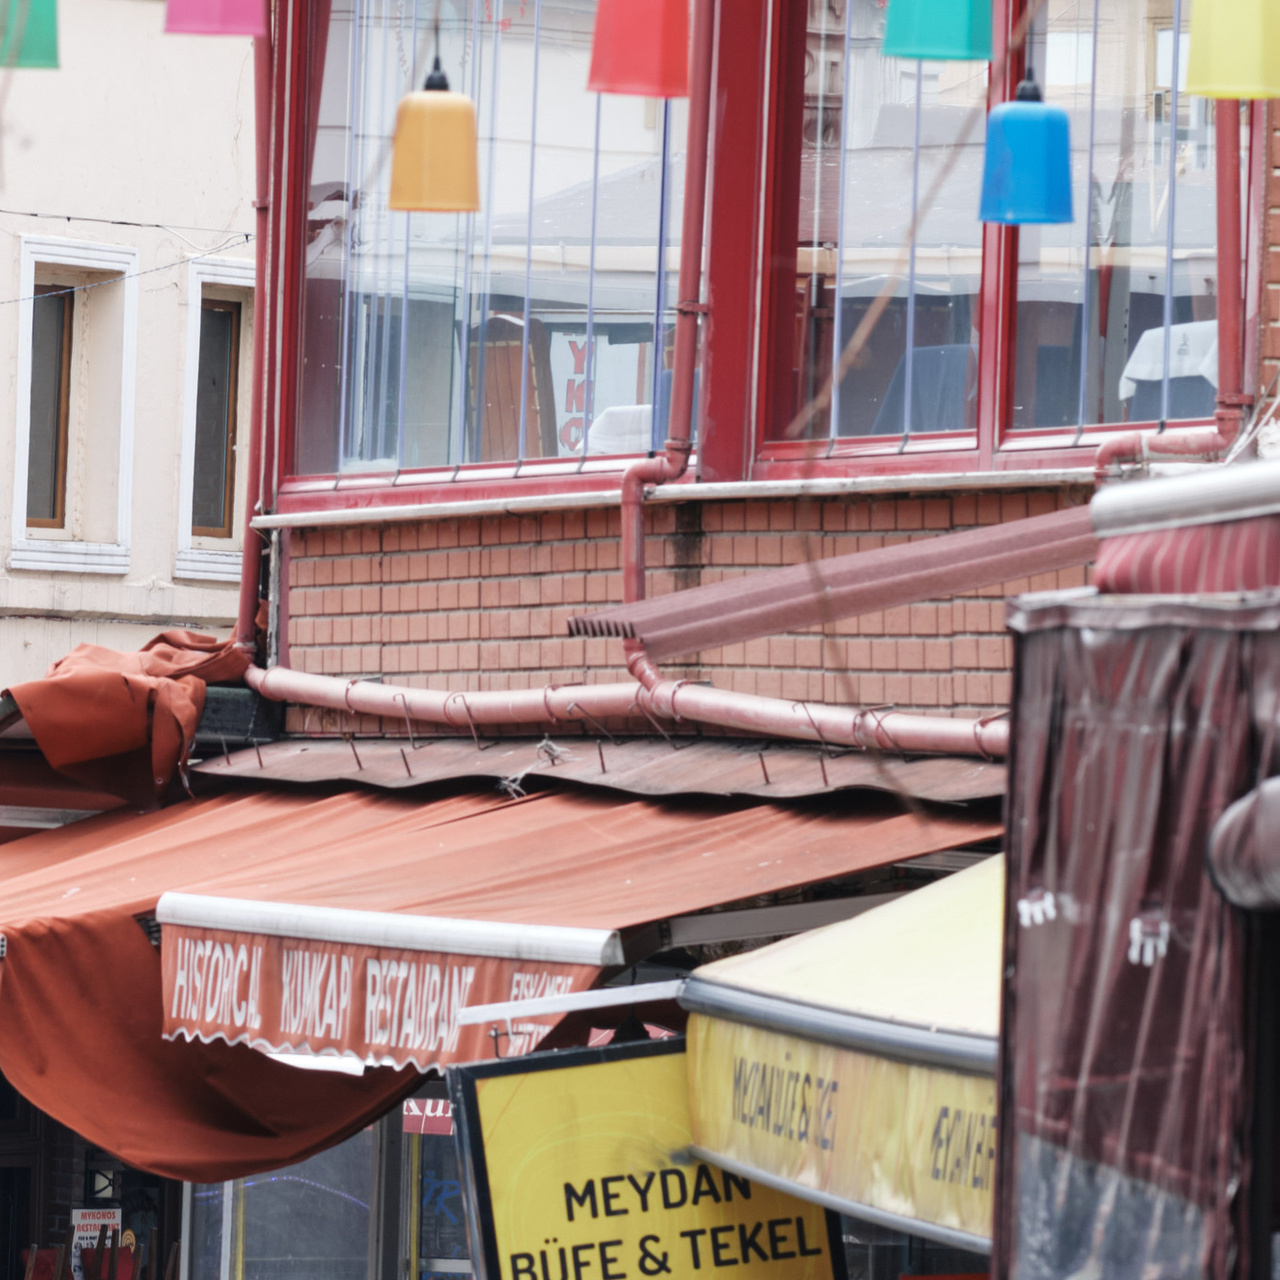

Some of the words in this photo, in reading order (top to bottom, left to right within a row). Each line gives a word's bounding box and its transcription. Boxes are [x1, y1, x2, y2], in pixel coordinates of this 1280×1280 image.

[171, 937, 262, 1031] HISTORCAL
[81, 1211, 116, 1221] MYKONOS
[563, 1163, 752, 1222] MEYDAN
[77, 1223, 119, 1232] RESTAUANT
[638, 1234, 672, 1276] &
[679, 1215, 822, 1270] TEKEL
